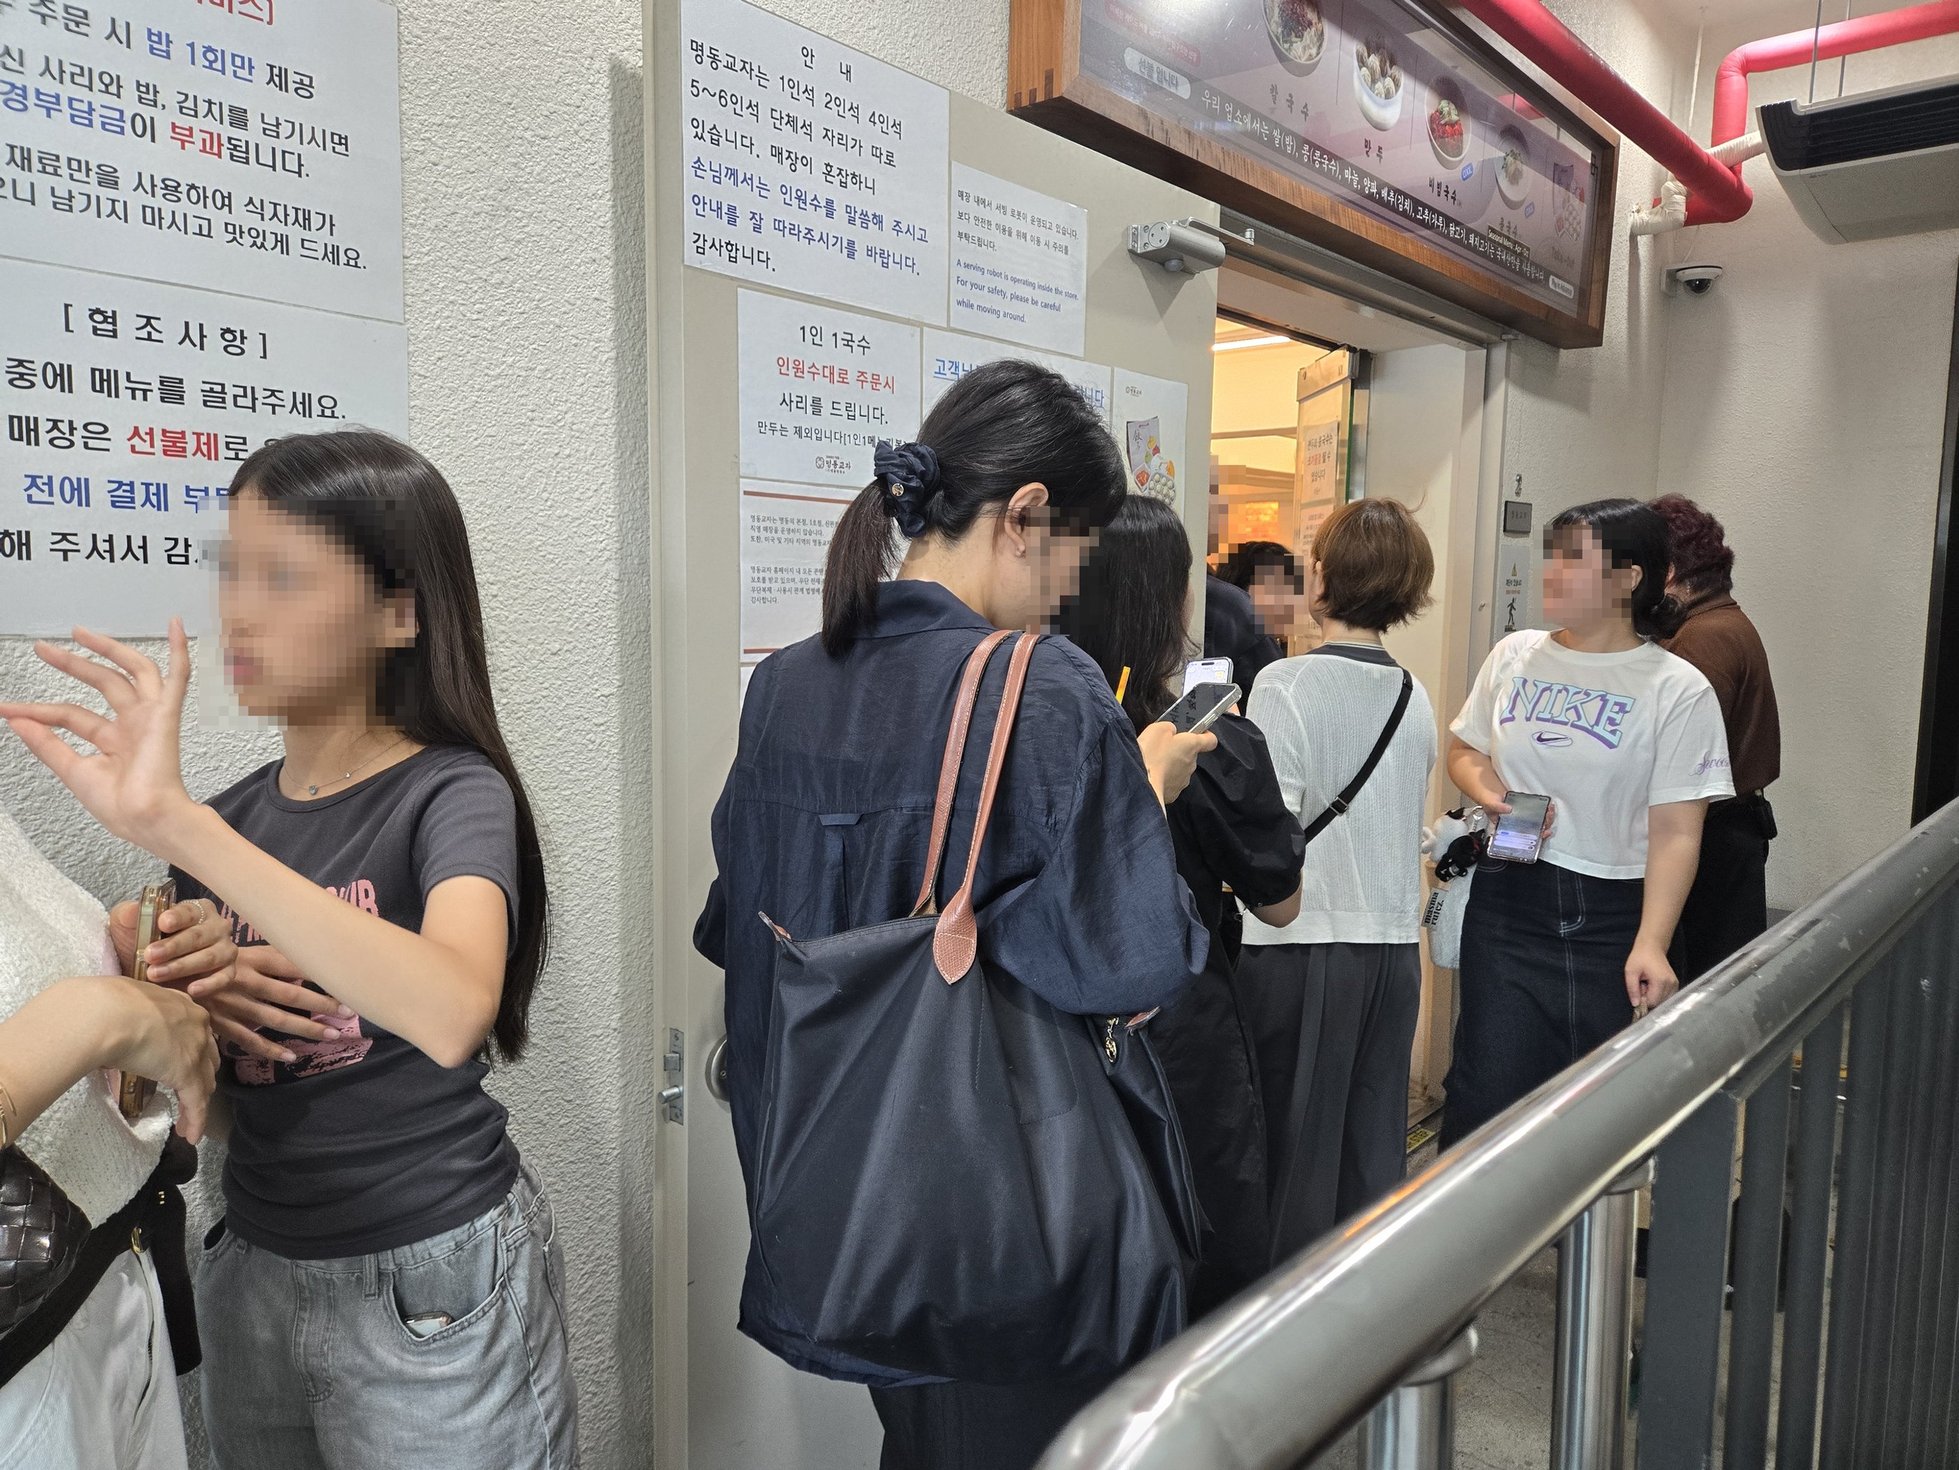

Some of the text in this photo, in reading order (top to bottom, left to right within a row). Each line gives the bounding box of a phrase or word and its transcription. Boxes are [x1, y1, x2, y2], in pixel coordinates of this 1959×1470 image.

[28, 0, 317, 100] 주문 시 밥 1회만 제공
[801, 46, 853, 83] 안 내
[38, 54, 124, 100] 사리와
[135, 79, 167, 111] 밥,
[176, 89, 250, 130] 김치를
[260, 112, 351, 158] 남기시면
[690, 38, 903, 141] 명동교자는 1인석 2인석 4인석
[0, 79, 311, 179] 경부담금이 부과됩니다.
[690, 78, 897, 169] 5~6인석 단체석 자리가 따로
[1202, 89, 1220, 115] 우리
[1224, 102, 1269, 141] 업소에서는
[690, 117, 877, 196] 있습니다. 매장이 혼잡하니
[4, 142, 338, 238] 재료만을 사용하여 식자재가
[691, 156, 929, 244] 손님께서는 인원수를 말씀해 주시고
[957, 189, 971, 204] 매장
[973, 194, 993, 211] 내에서
[995, 202, 1008, 216] 서빙
[1010, 207, 1028, 224] 로봇이
[1030, 215, 1053, 232] 운영되고
[50, 185, 130, 224] 남기지
[142, 203, 214, 240] 마시고
[223, 221, 292, 257] 맛있게
[300, 238, 368, 271] 드세요.
[691, 194, 921, 277] 안내를 잘 따라주시기를 바랍니다.
[957, 210, 971, 225] 보다
[973, 214, 993, 231] 안전한
[1015, 228, 1028, 243] 위해
[957, 231, 998, 252] 부탁드립니다.
[691, 232, 777, 273] 감사합니다.
[956, 259, 1080, 301] A serving robot is operating inside the store.
[956, 276, 968, 287] For
[969, 282, 986, 293] your
[1009, 292, 1030, 304] please
[1030, 297, 1039, 307] be
[1040, 300, 1062, 313] careful
[956, 299, 1027, 323] while moving around.
[800, 325, 871, 355] 1인 1국수
[5, 356, 347, 420] 중에 메뉴를 골라주세요.
[776, 356, 896, 394] 인원수대로 주문시
[757, 421, 790, 437] 만두는
[779, 392, 889, 425] 사리를 드립니다.
[8, 414, 249, 461] 매장은 선불제로
[22, 473, 92, 508] 전에
[106, 478, 169, 513] 결제
[0, 529, 33, 562] 해
[49, 531, 149, 565] 주셔서
[1500, 677, 1637, 750] NIKE
